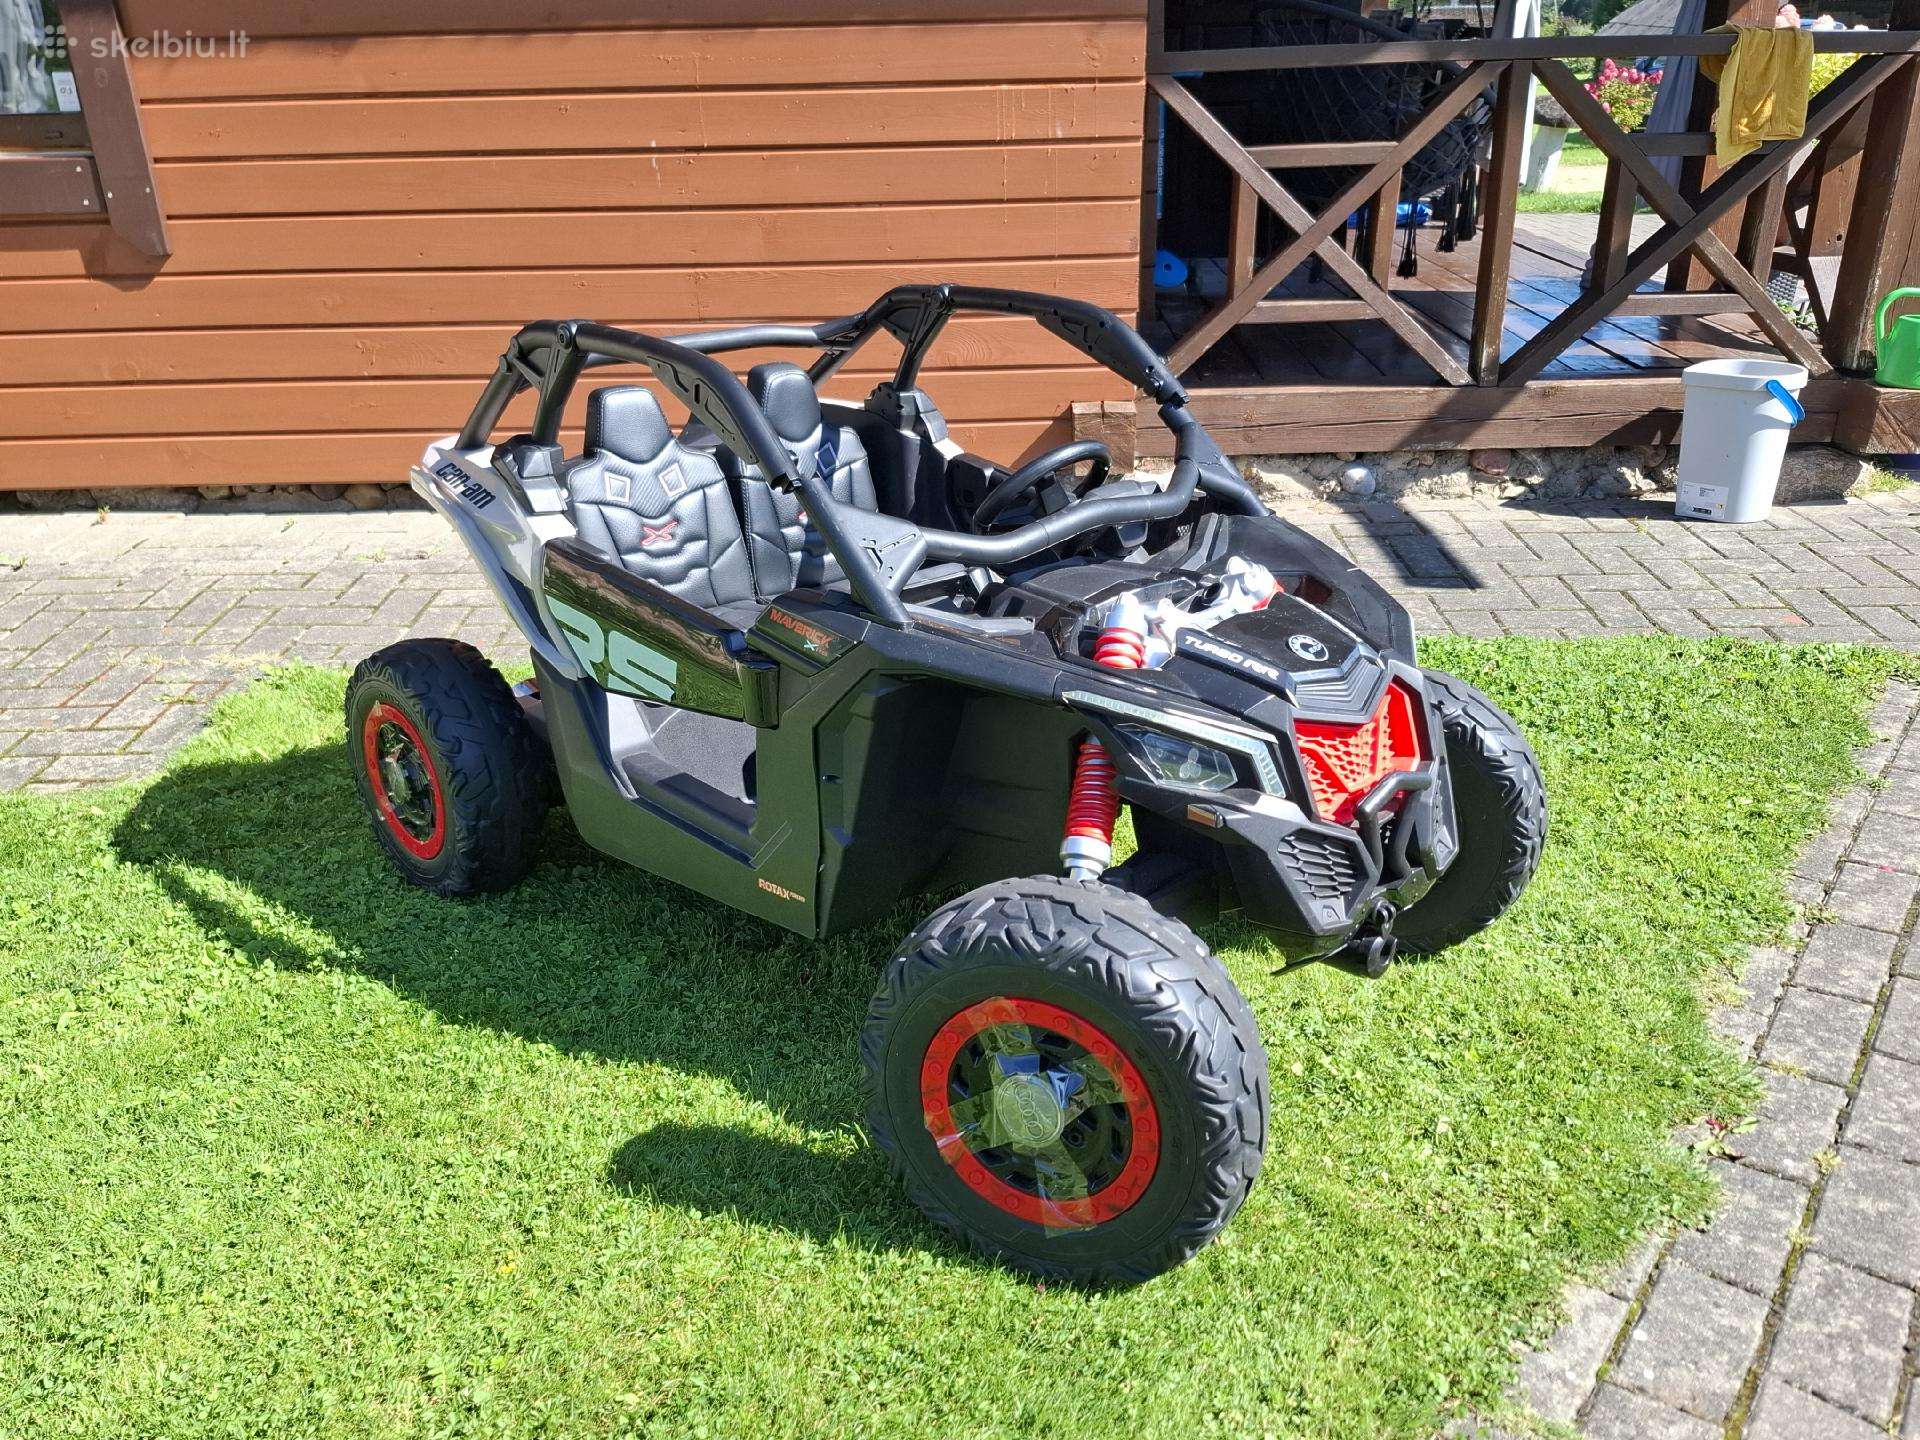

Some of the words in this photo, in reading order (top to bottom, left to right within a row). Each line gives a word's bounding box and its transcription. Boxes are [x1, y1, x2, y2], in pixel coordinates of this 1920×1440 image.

[436, 462, 496, 510] can-am
[770, 608, 833, 645] MAVERICK
[1185, 635, 1244, 664] TURBO
[758, 877, 790, 900] ROTAX
